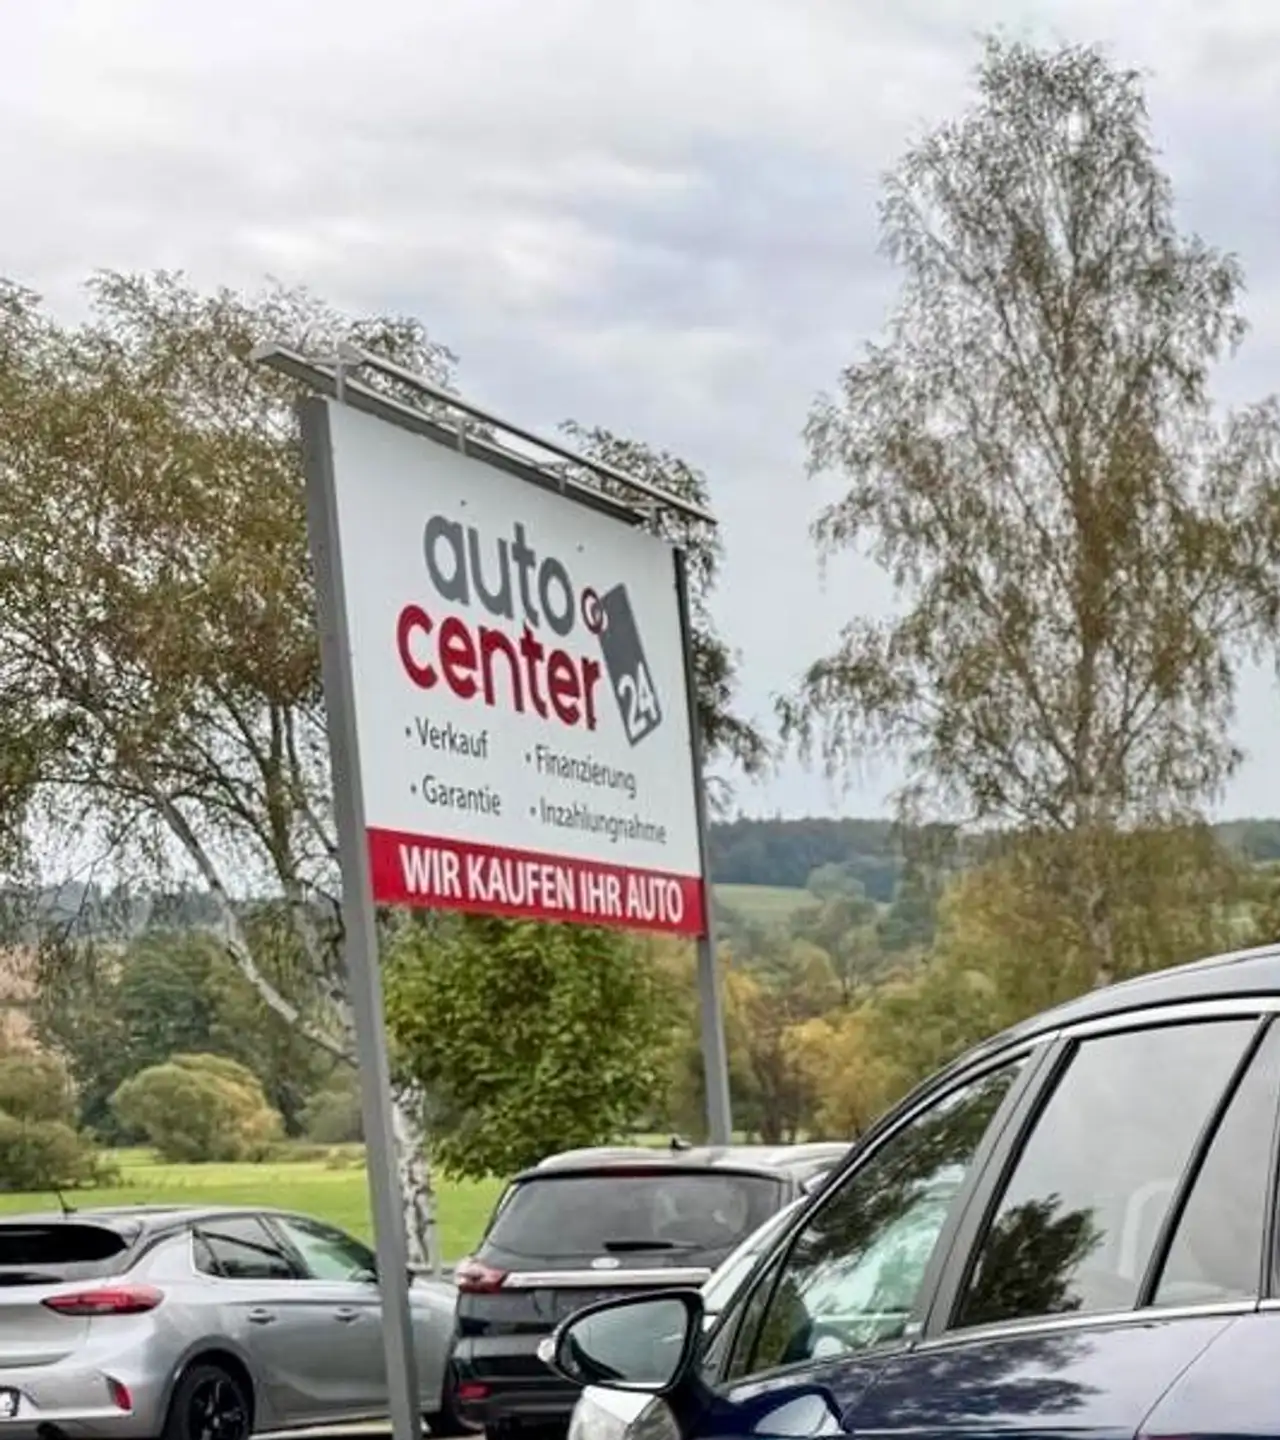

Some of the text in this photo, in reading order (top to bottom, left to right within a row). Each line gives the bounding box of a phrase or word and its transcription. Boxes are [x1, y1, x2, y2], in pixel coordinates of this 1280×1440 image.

[424, 514, 575, 636] auto
[397, 604, 601, 731] center
[617, 661, 659, 740] 24
[415, 716, 488, 758] Verkauf
[422, 775, 501, 816] Garantie
[535, 744, 637, 798] Finanzierung
[540, 797, 667, 844] Inzahlungnahme
[399, 844, 684, 924] WIR KAUFEN IHR AUTO
